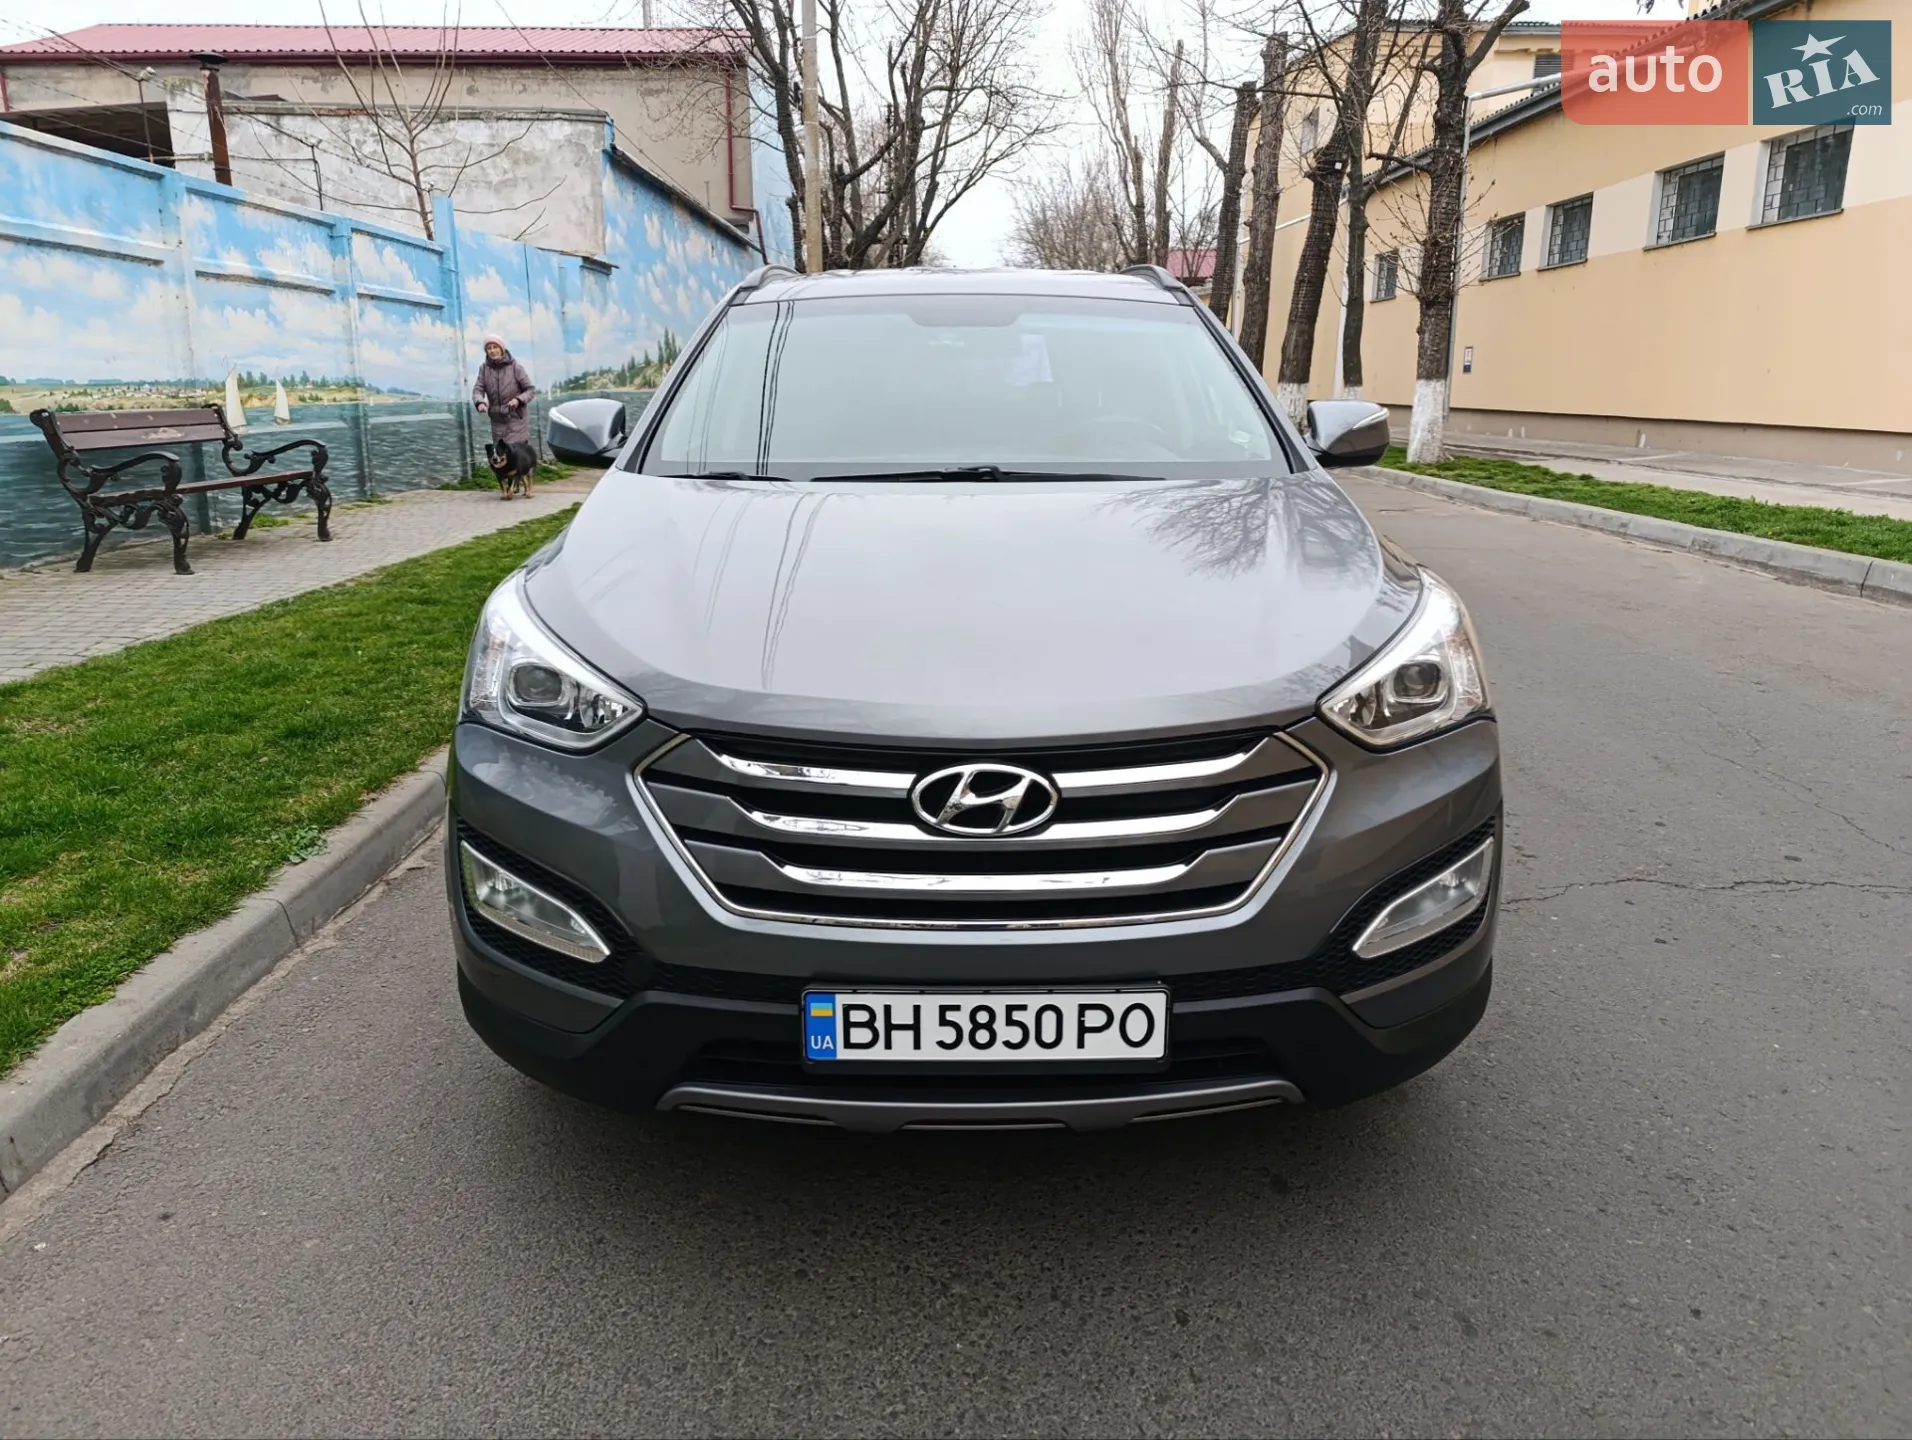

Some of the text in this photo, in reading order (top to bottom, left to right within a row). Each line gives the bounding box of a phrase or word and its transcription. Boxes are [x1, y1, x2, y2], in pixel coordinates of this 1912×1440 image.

[811, 1035, 834, 1050] UA
[842, 1002, 1155, 1051] BH 5850 PO
